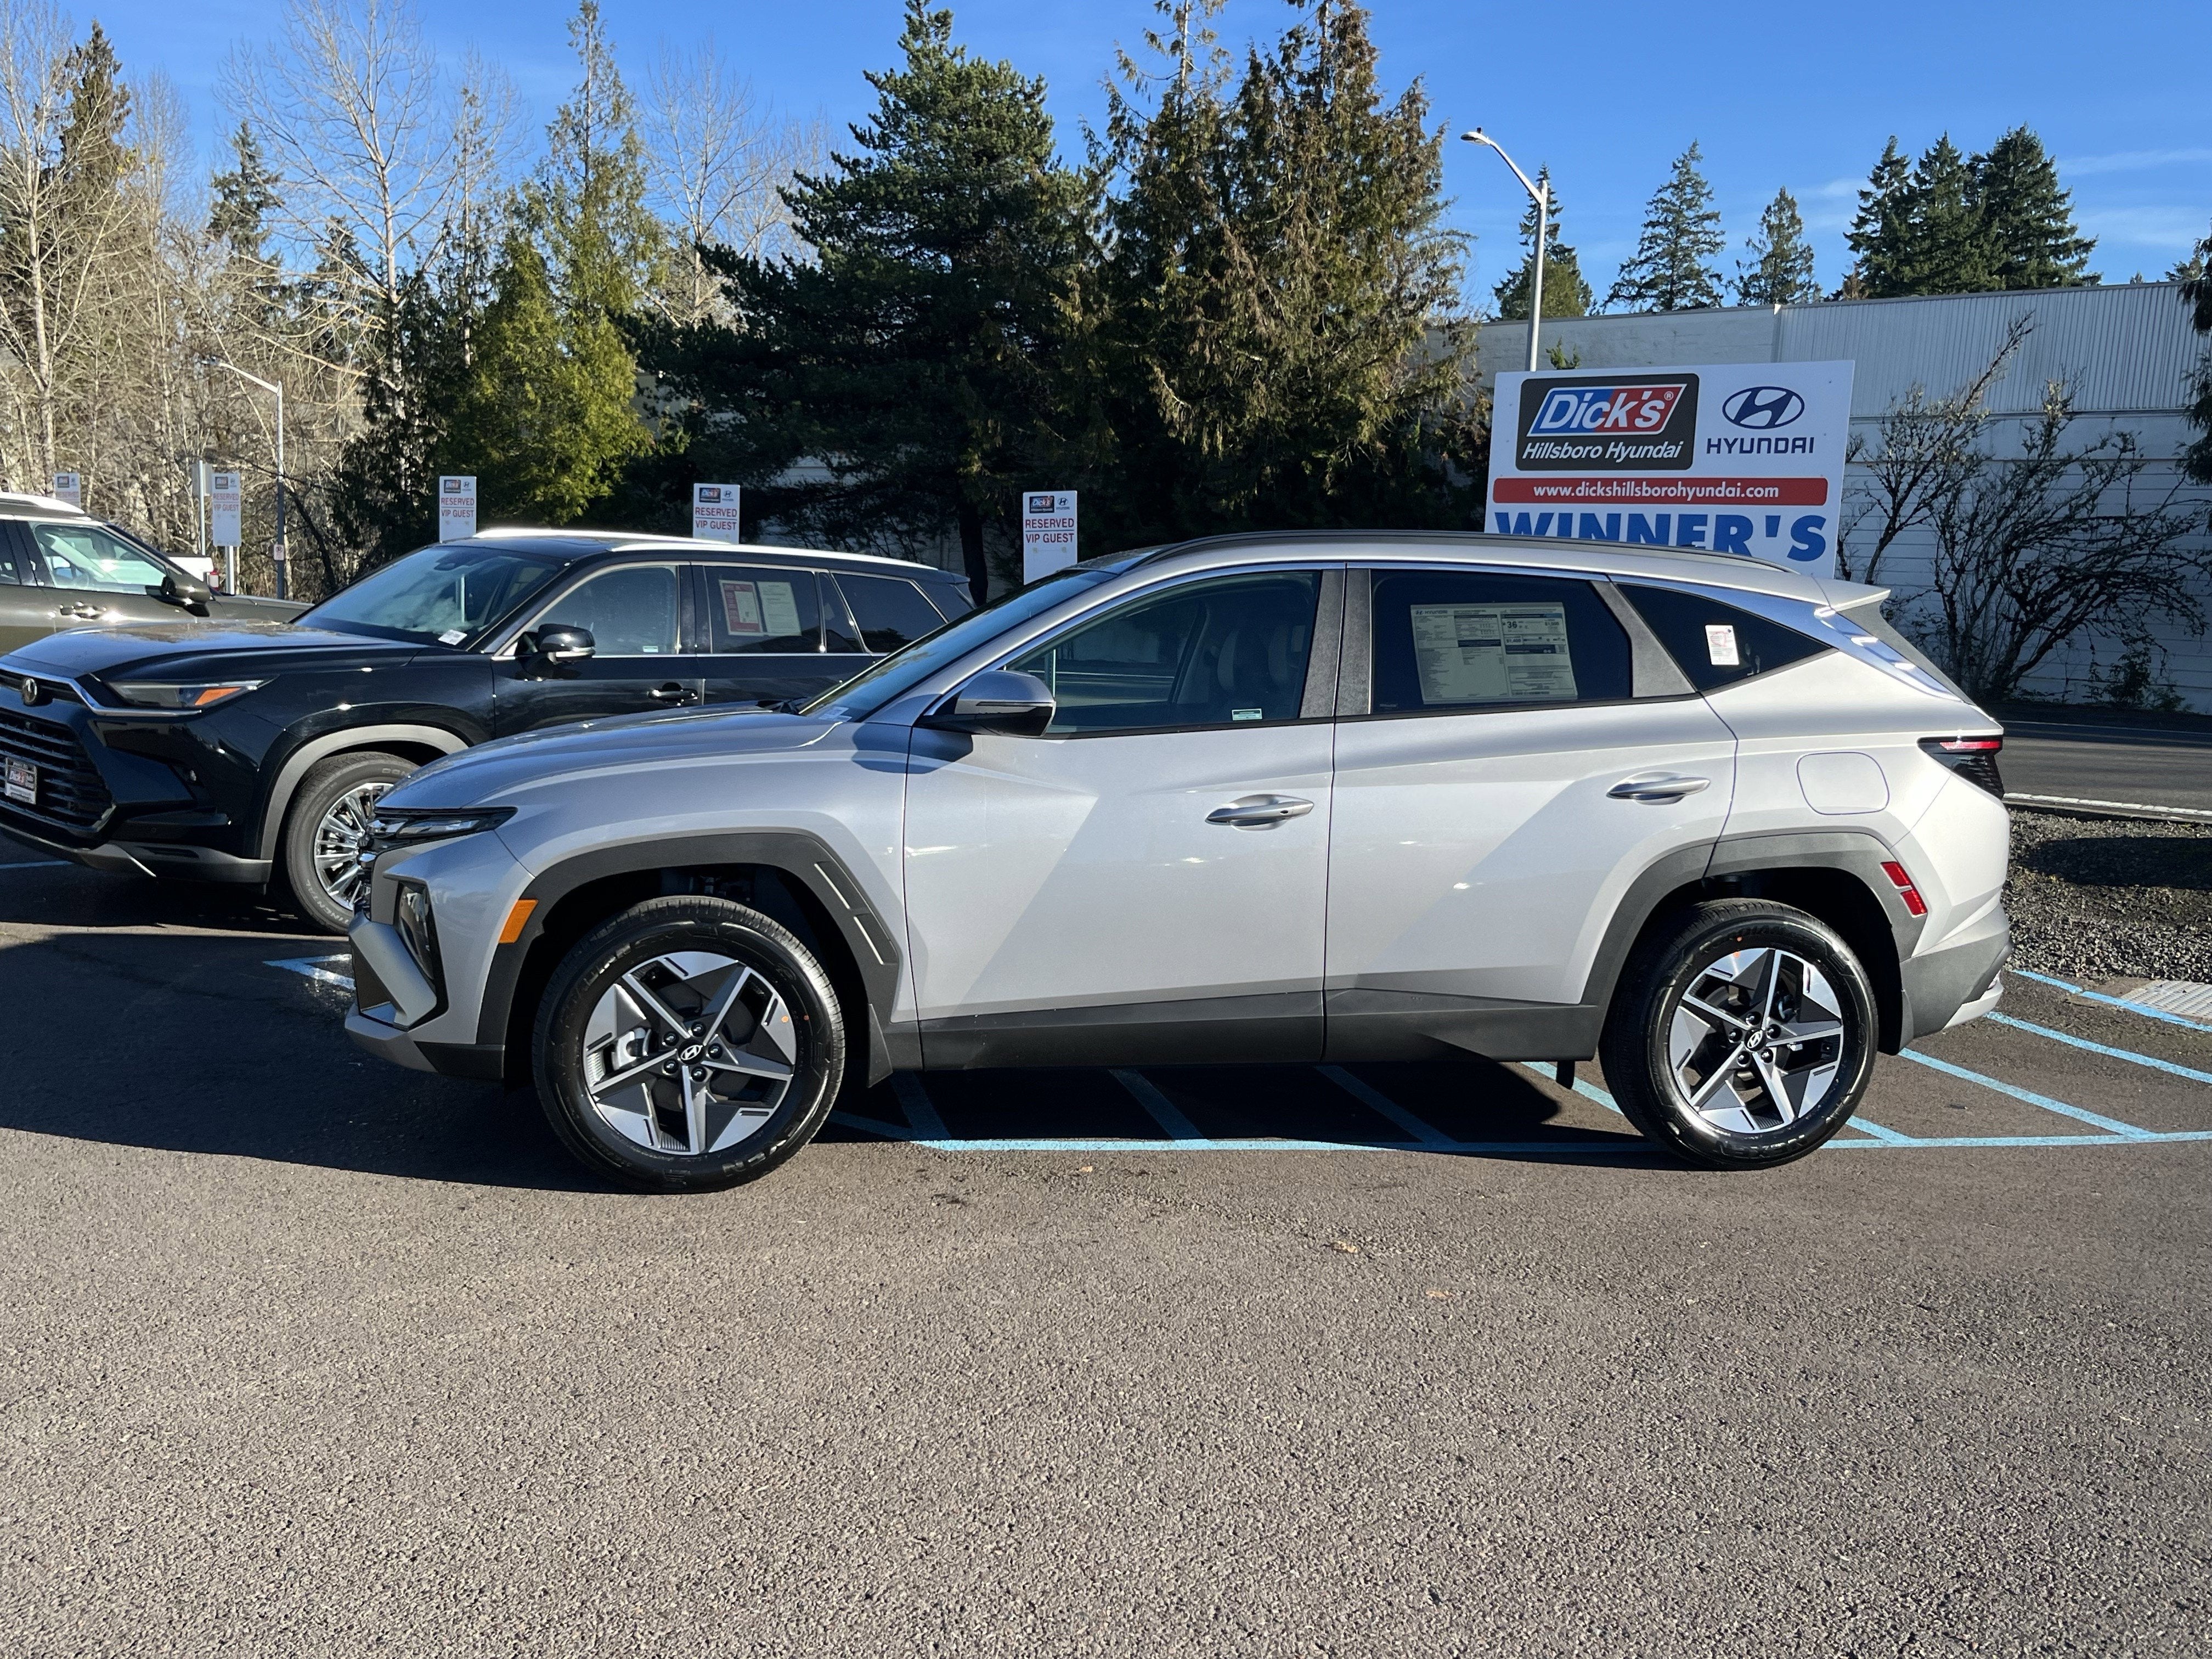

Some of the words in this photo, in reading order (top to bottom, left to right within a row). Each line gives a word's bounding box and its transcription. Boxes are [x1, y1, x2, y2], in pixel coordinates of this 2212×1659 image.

[1539, 391, 1665, 430] Dick's
[1522, 441, 1602, 459] Hillsboro
[1605, 441, 1684, 463] Hyundai
[1706, 437, 1814, 454] HYUNDAI
[1533, 481, 1779, 501] www.dickshillsborohyundai.com
[695, 507, 737, 517] RESERVED
[695, 520, 708, 528] VIP
[710, 521, 737, 531] GUEST
[1025, 518, 1074, 528] RESERVED
[1026, 534, 1040, 544] VIP
[1043, 533, 1074, 543] GUEST
